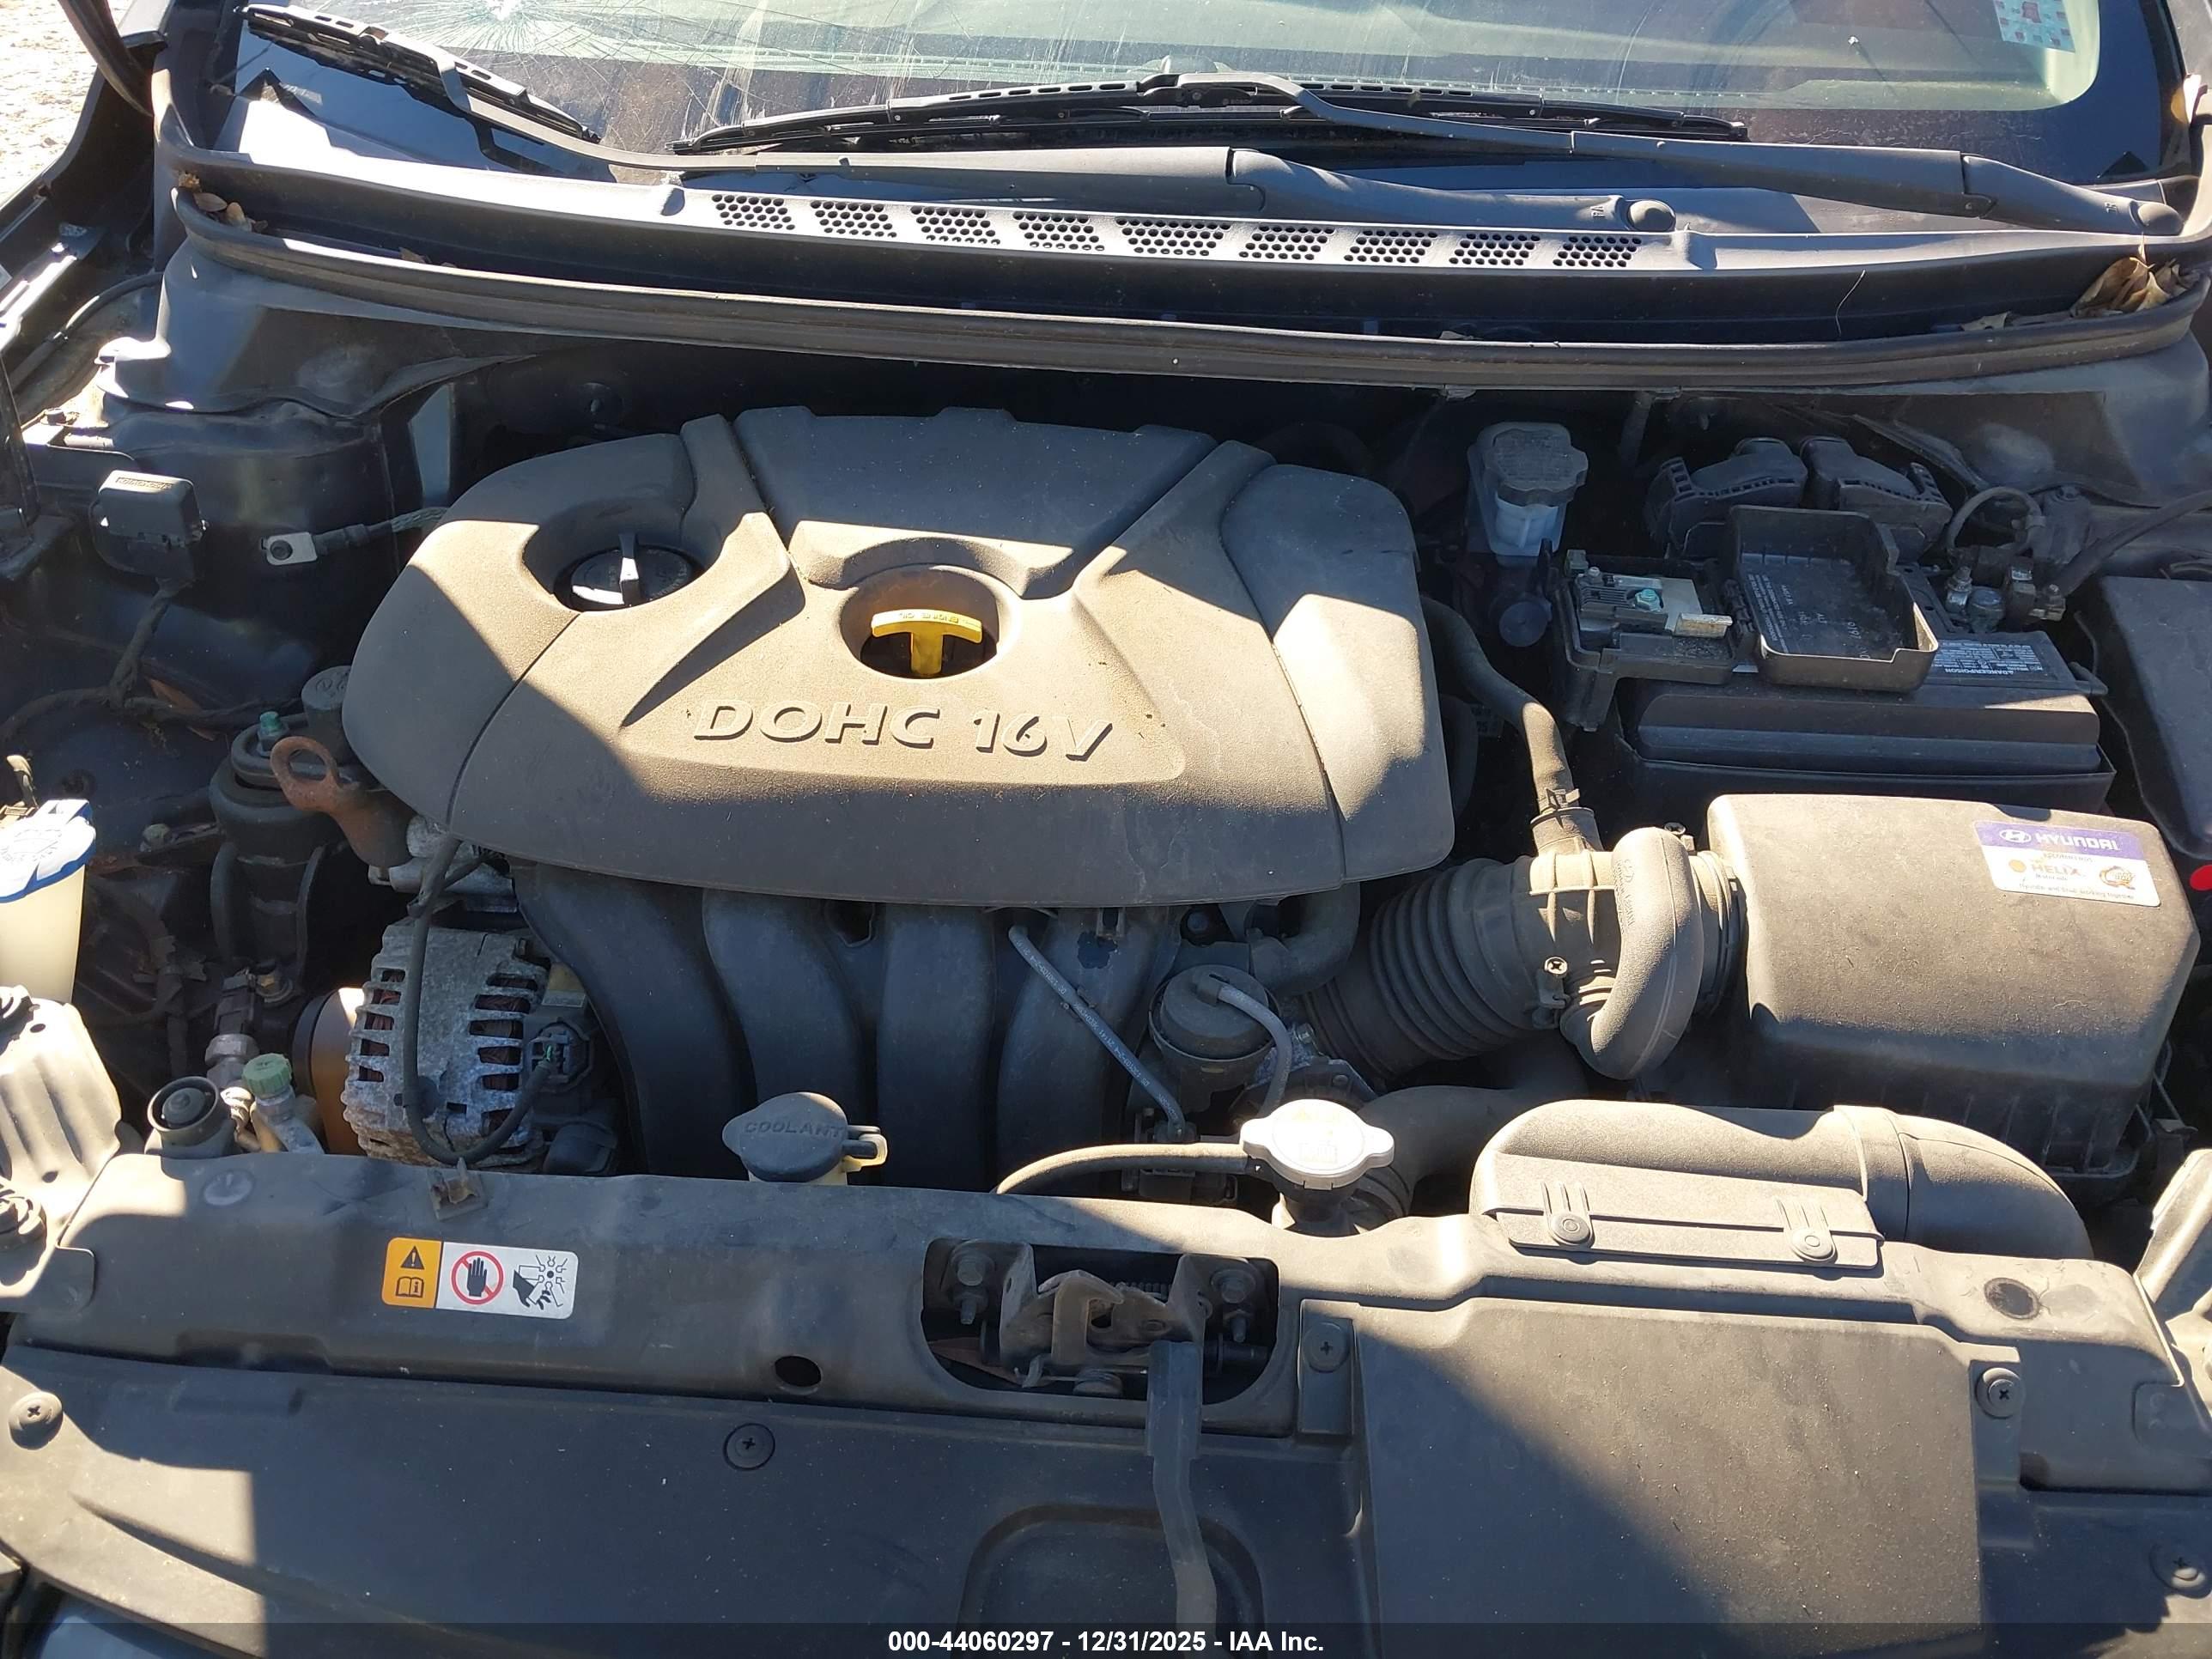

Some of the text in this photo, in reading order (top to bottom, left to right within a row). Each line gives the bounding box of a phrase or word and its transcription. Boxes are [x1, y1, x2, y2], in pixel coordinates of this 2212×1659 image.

[694, 700, 1113, 762] DOHC 16V
[2036, 832, 2119, 851] HYUNDAI
[744, 1121, 844, 1138] COOLANT
